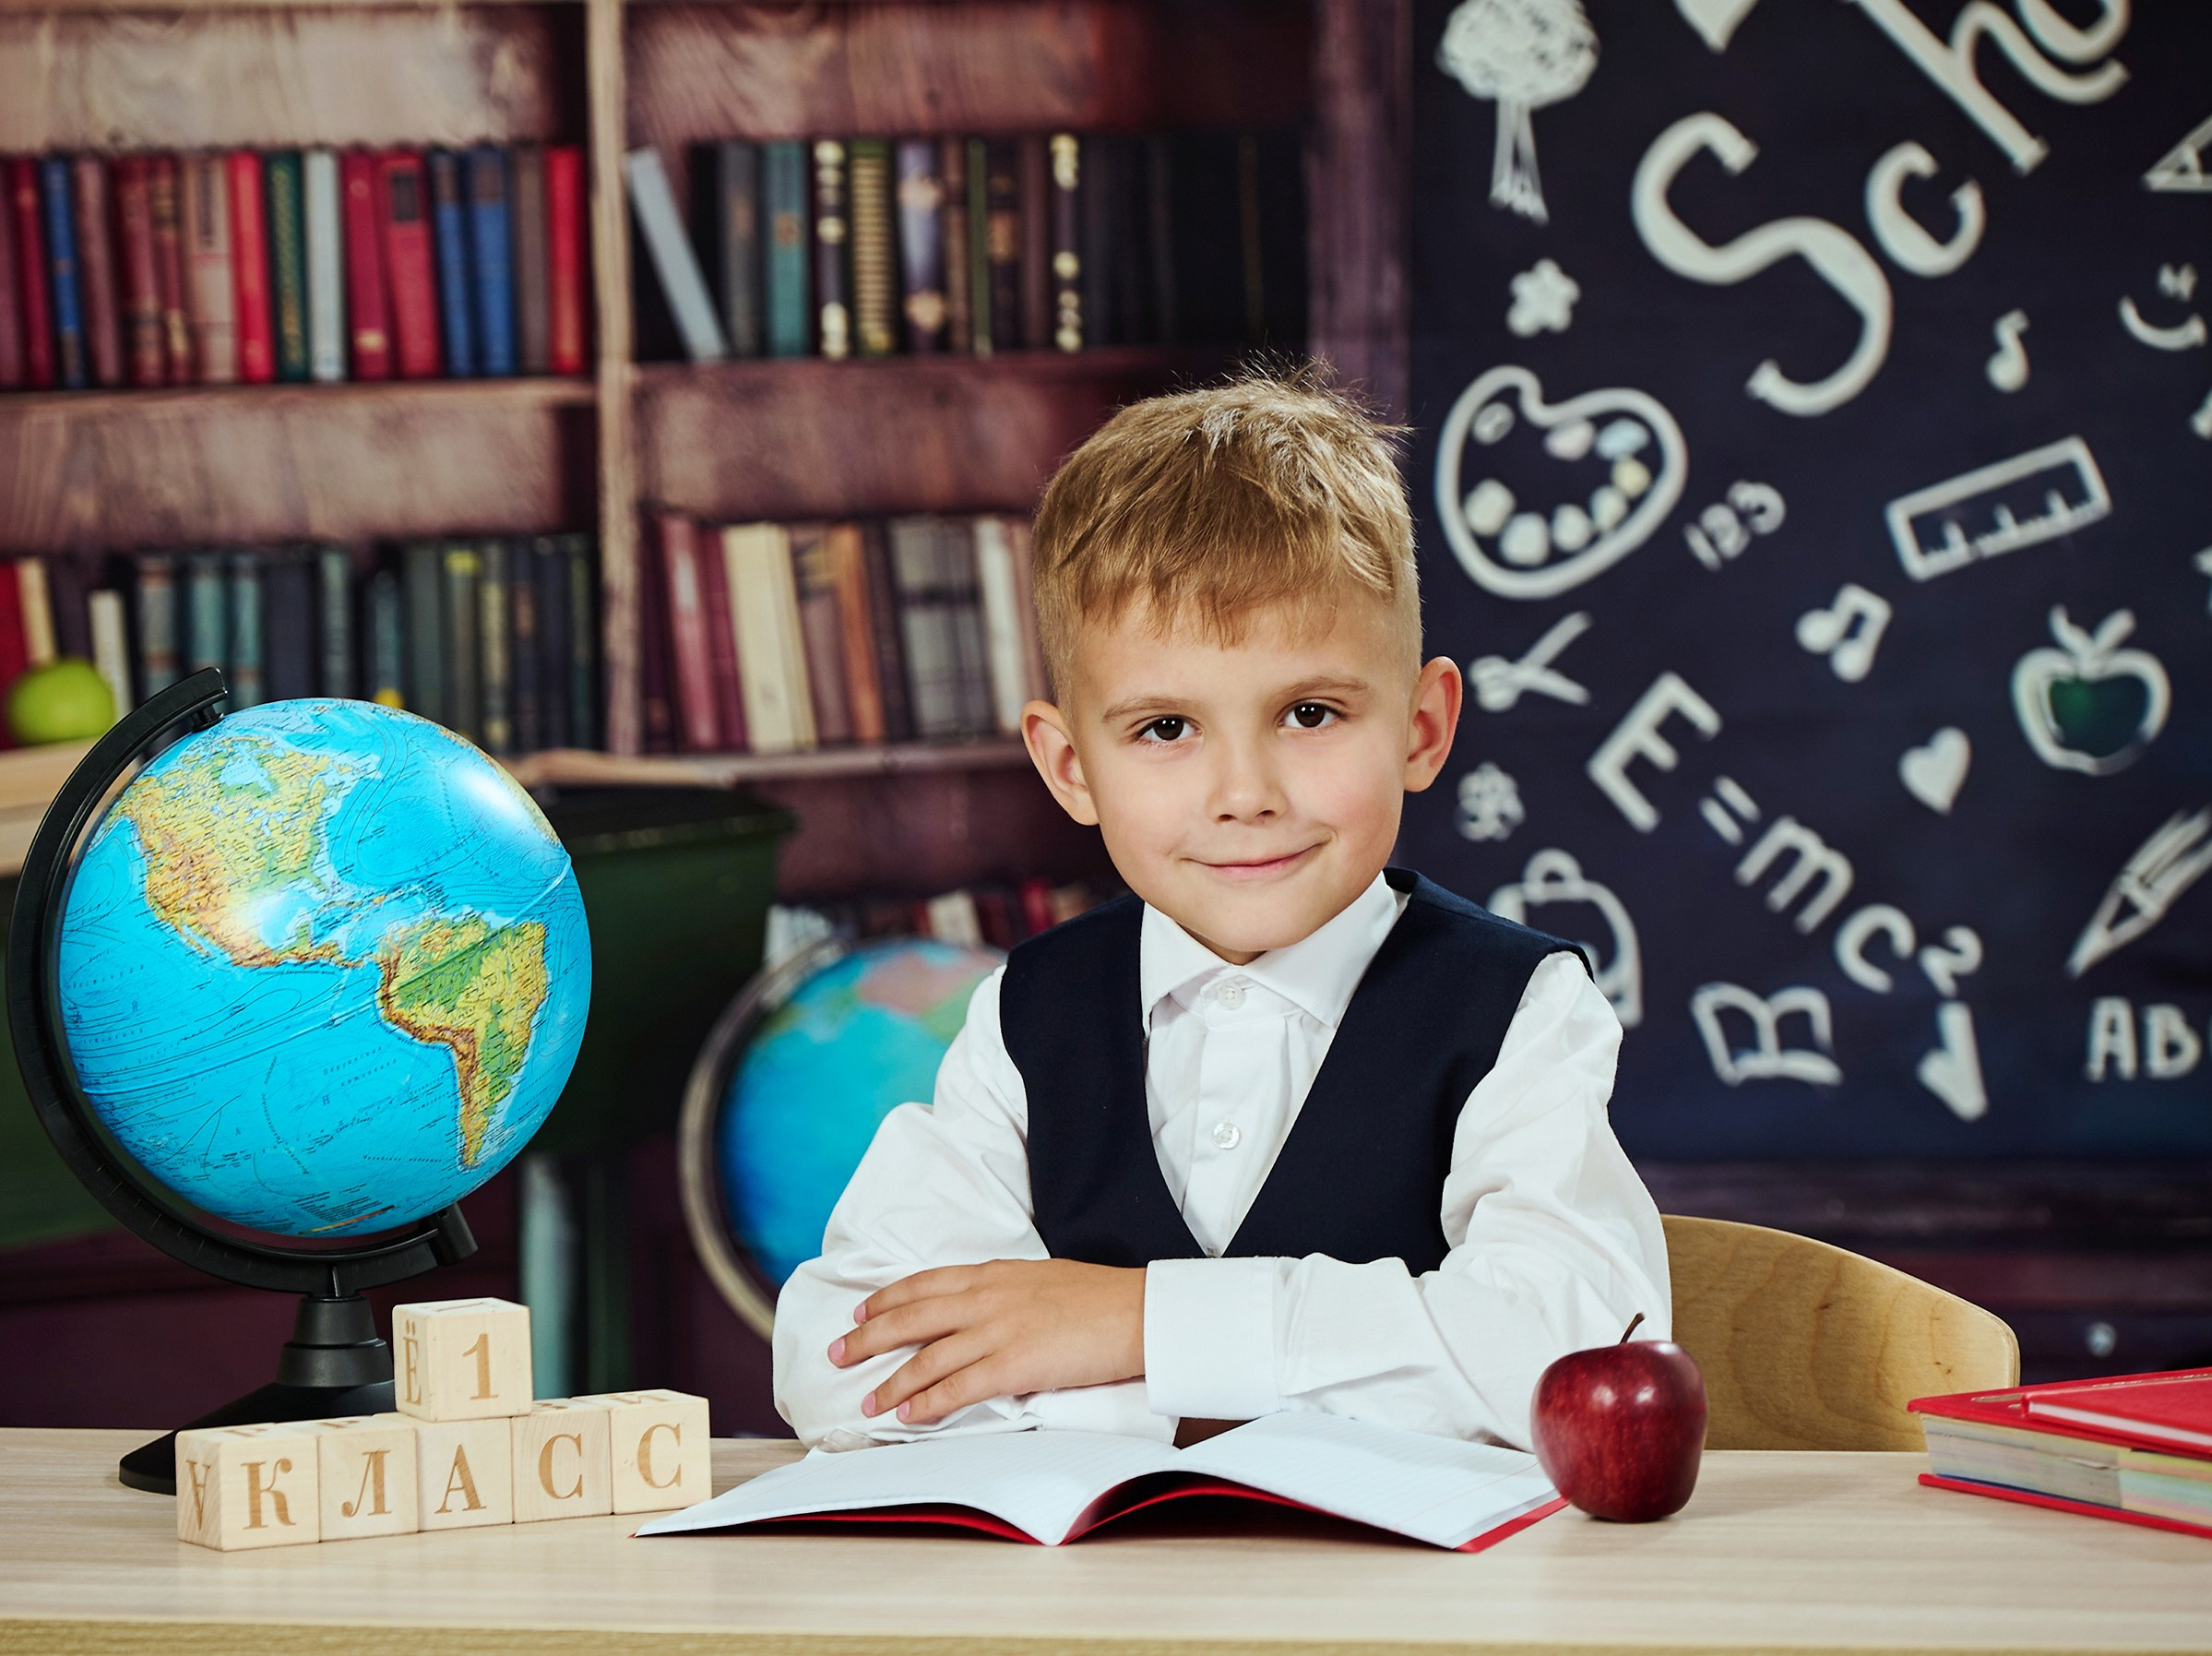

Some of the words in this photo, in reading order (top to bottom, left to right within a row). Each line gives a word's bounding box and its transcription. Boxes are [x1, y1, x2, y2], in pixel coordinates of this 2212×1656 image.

[2085, 995, 2212, 1083] AB
[462, 1333, 499, 1400] 1
[240, 1423, 683, 1531] КЛАСС
